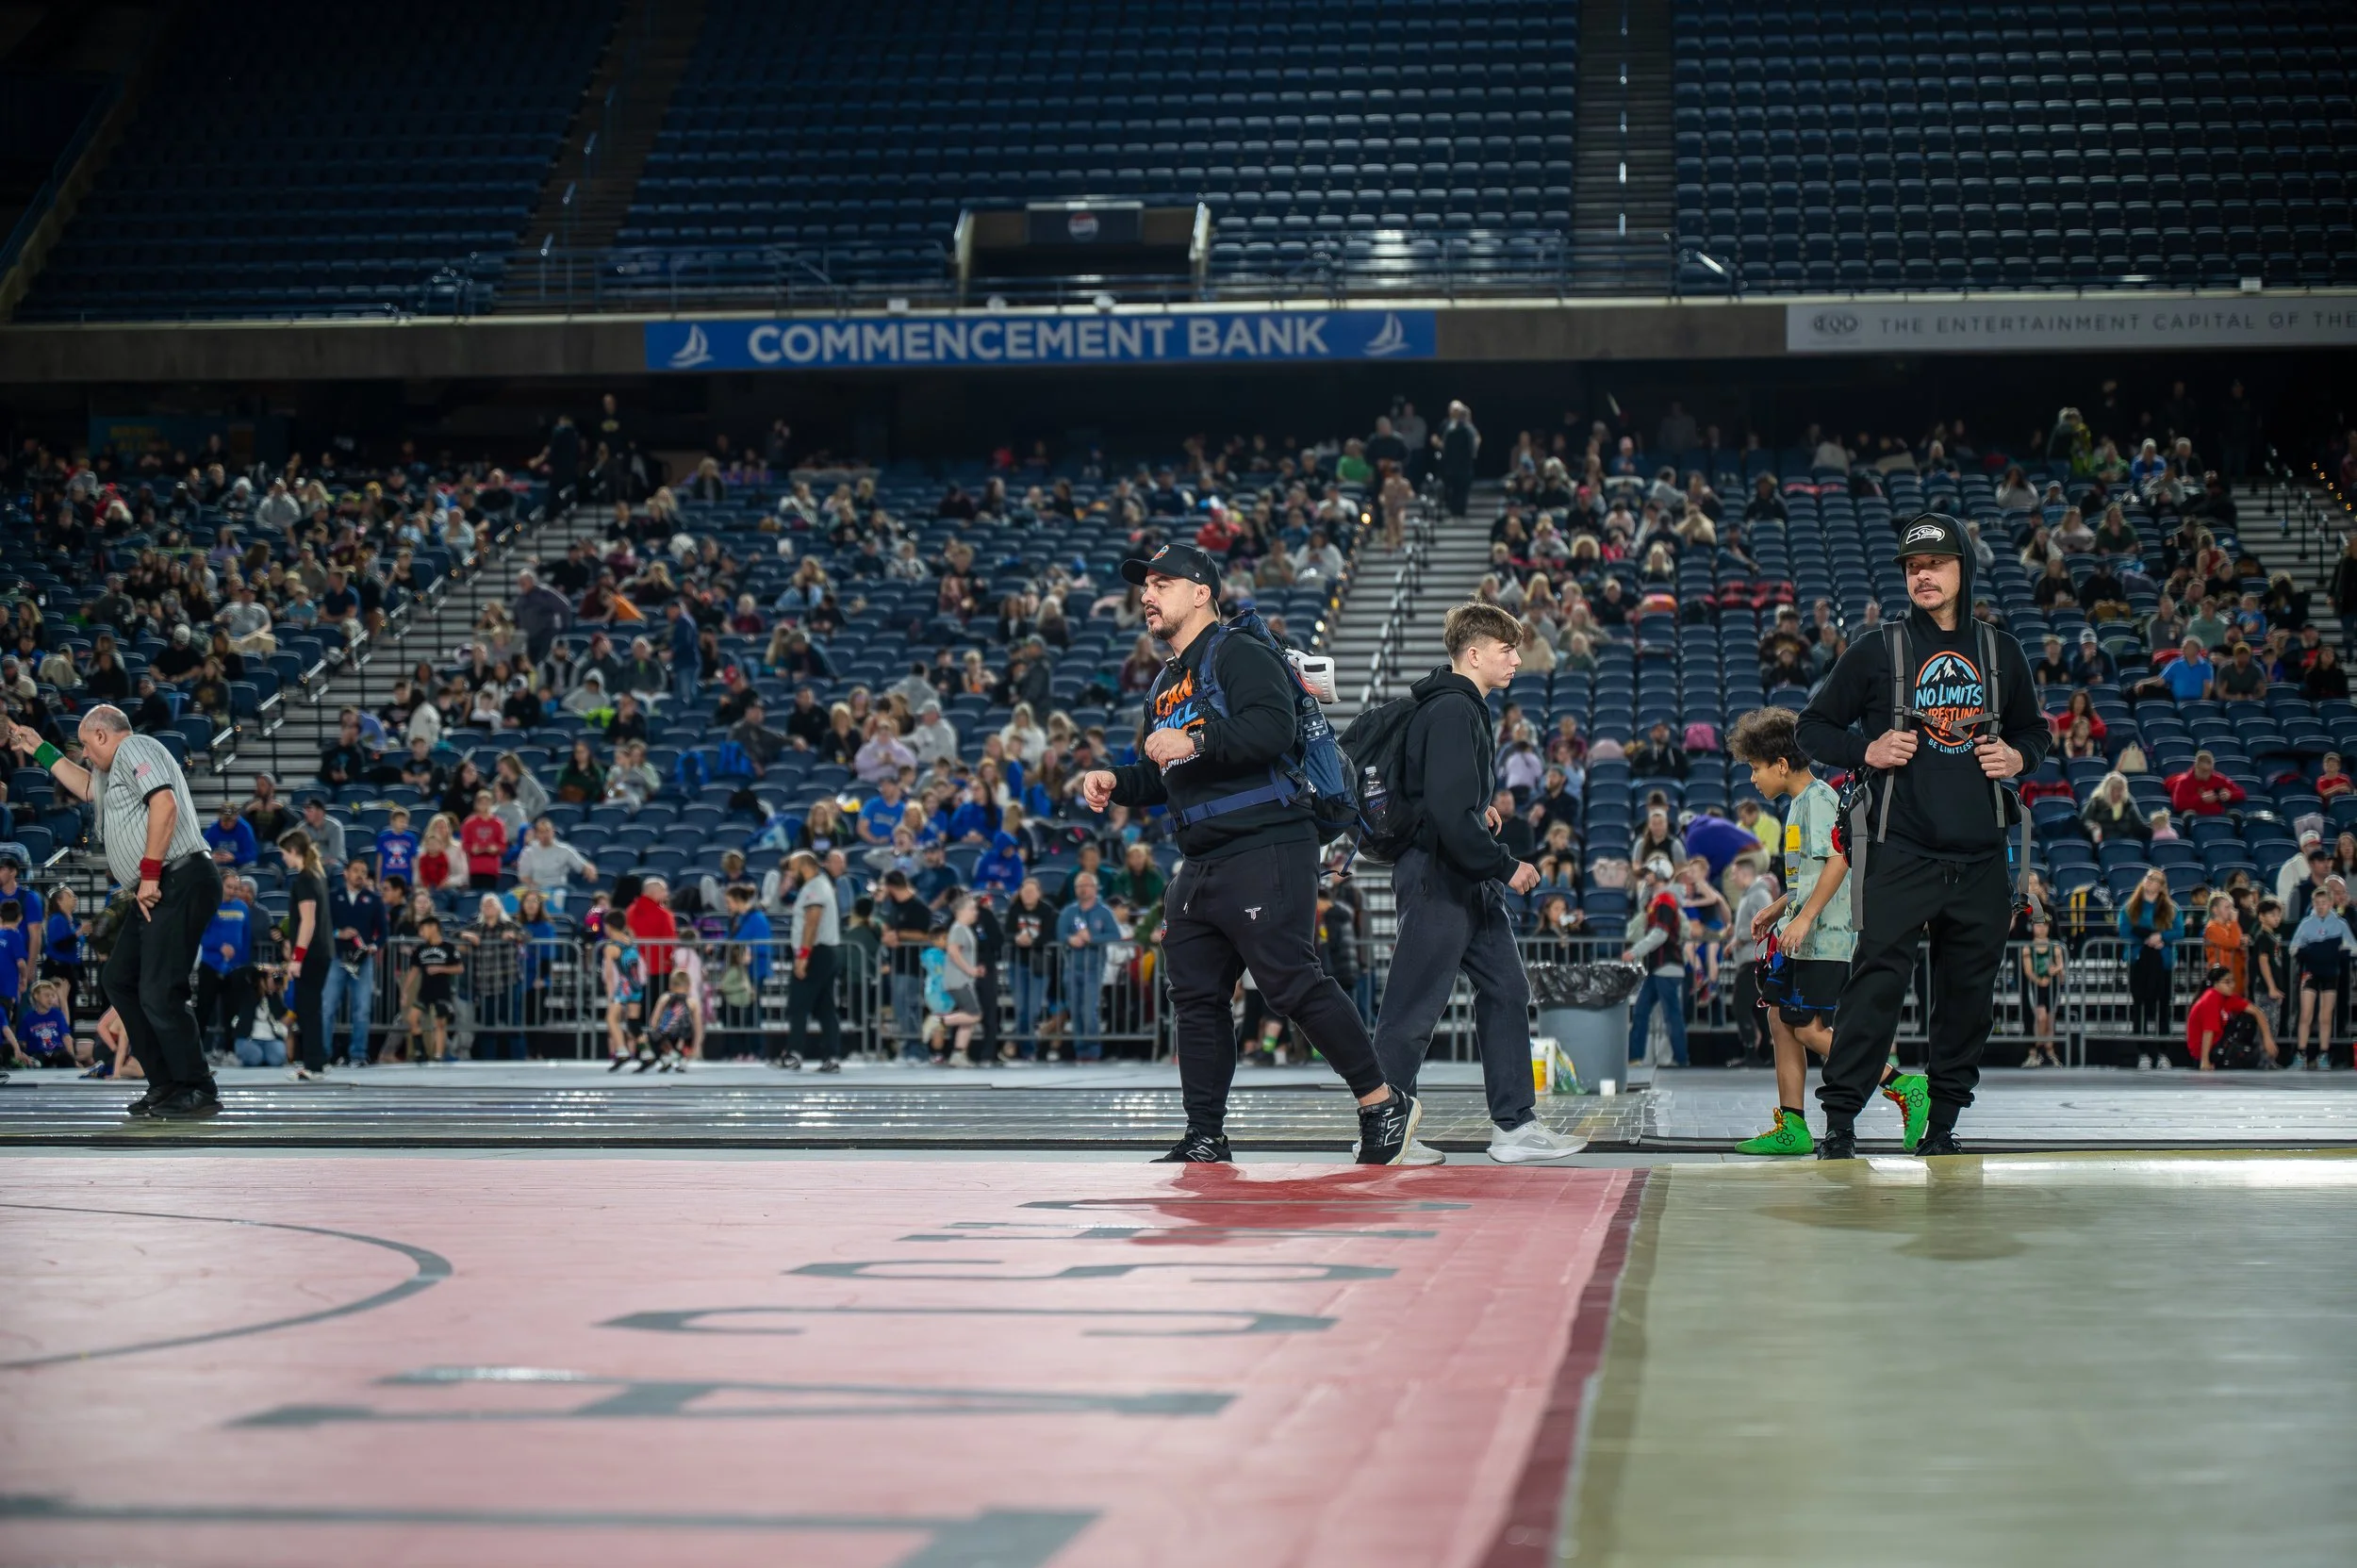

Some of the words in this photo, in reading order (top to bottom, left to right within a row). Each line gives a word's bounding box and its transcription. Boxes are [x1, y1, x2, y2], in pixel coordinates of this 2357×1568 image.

[1879, 317, 1924, 335] THE
[1937, 313, 2140, 334] ENTERTAINMENT
[2152, 312, 2256, 331] CAPITAL
[2268, 310, 2301, 329] OF
[2313, 309, 2357, 329] THE
[748, 319, 1174, 363] COMMENCEMENT
[1188, 316, 1329, 357] BANK
[1156, 668, 1193, 717] CAN
[1915, 685, 1937, 709] NO
[1937, 684, 1984, 706] LIMITS
[1921, 706, 1984, 721] RESTLING
[1928, 738, 1938, 750] BE
[1939, 739, 1974, 754] LIMITLESS
